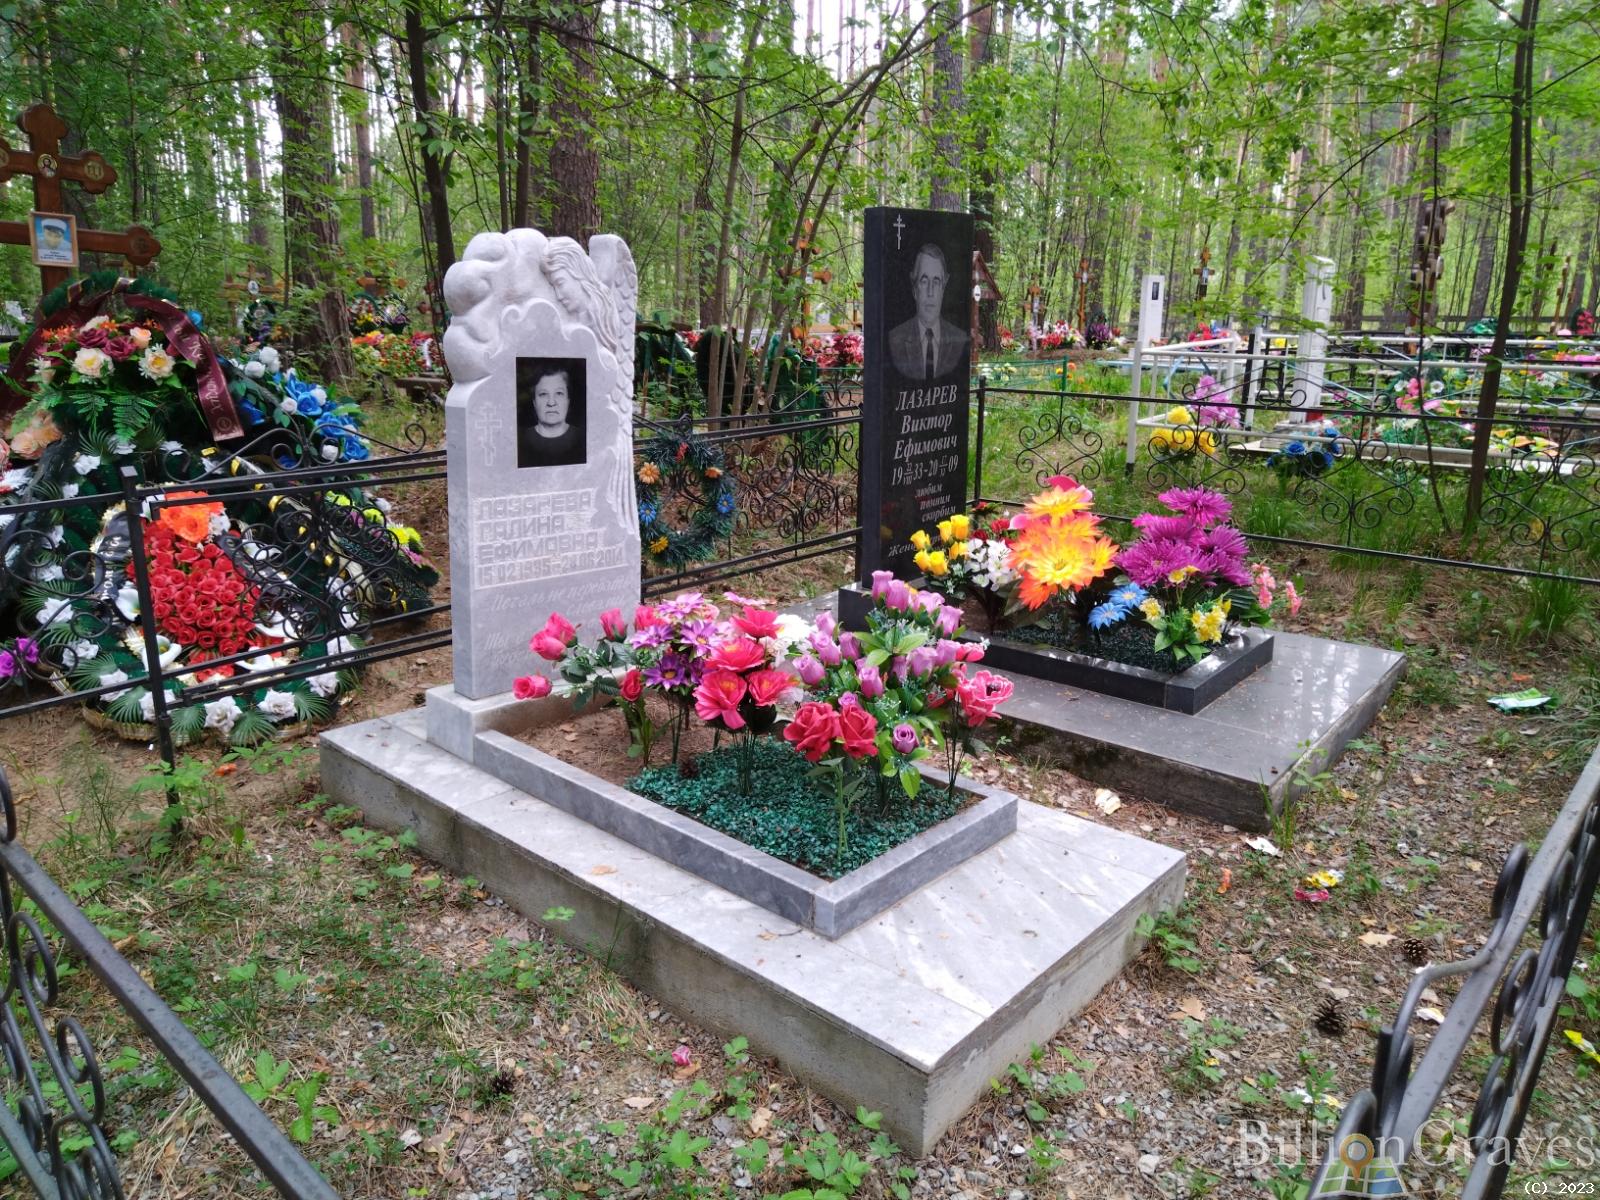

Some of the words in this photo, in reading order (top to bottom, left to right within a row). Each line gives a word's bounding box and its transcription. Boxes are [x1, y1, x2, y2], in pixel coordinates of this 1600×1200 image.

[895, 384, 958, 411] ЛАЗАРЕВ
[901, 413, 953, 434] Виктор
[893, 434, 958, 463] Ефимович
[914, 483, 943, 498] любим
[920, 494, 951, 510] помним
[480, 490, 593, 519] ЛАЗАРЕВА
[922, 506, 956, 522] скорбим
[480, 515, 565, 542] ГАЛИНА
[479, 532, 598, 564] ЕФИМОВНА
